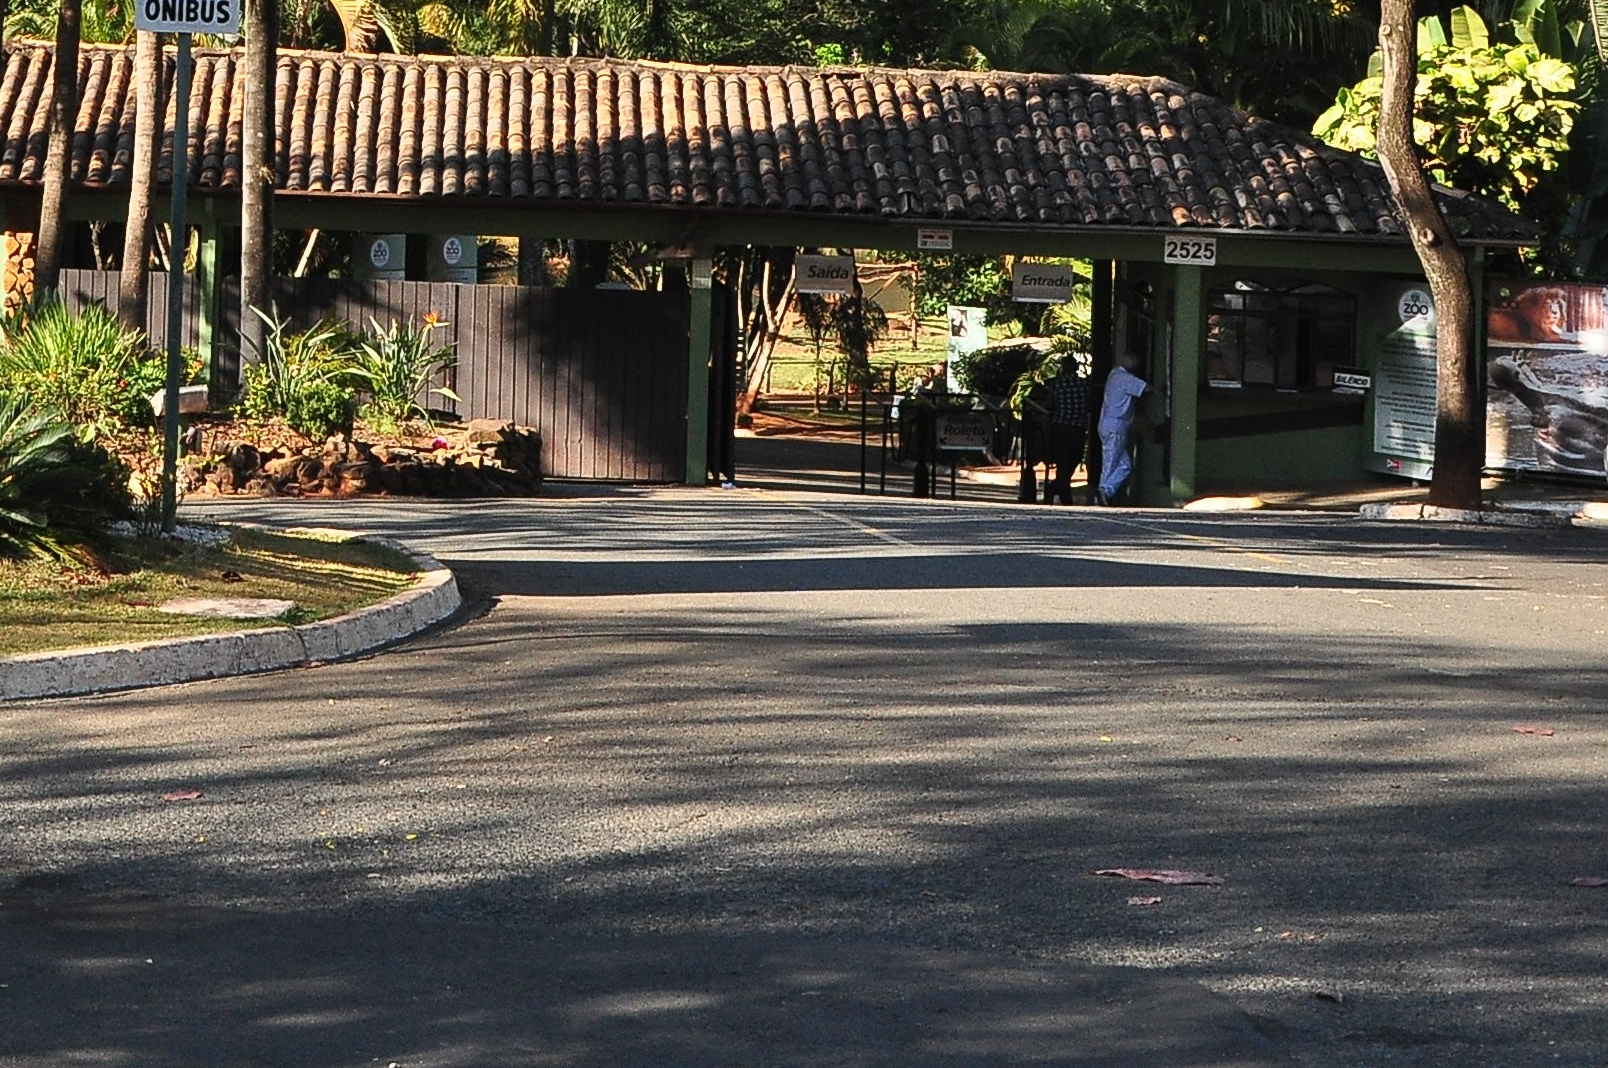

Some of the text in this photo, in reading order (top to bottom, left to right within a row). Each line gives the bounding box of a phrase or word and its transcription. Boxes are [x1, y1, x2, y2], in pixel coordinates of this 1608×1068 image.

[1166, 240, 1215, 260] 2525
[807, 264, 850, 280] Saída
[1021, 274, 1071, 287] Entrada
